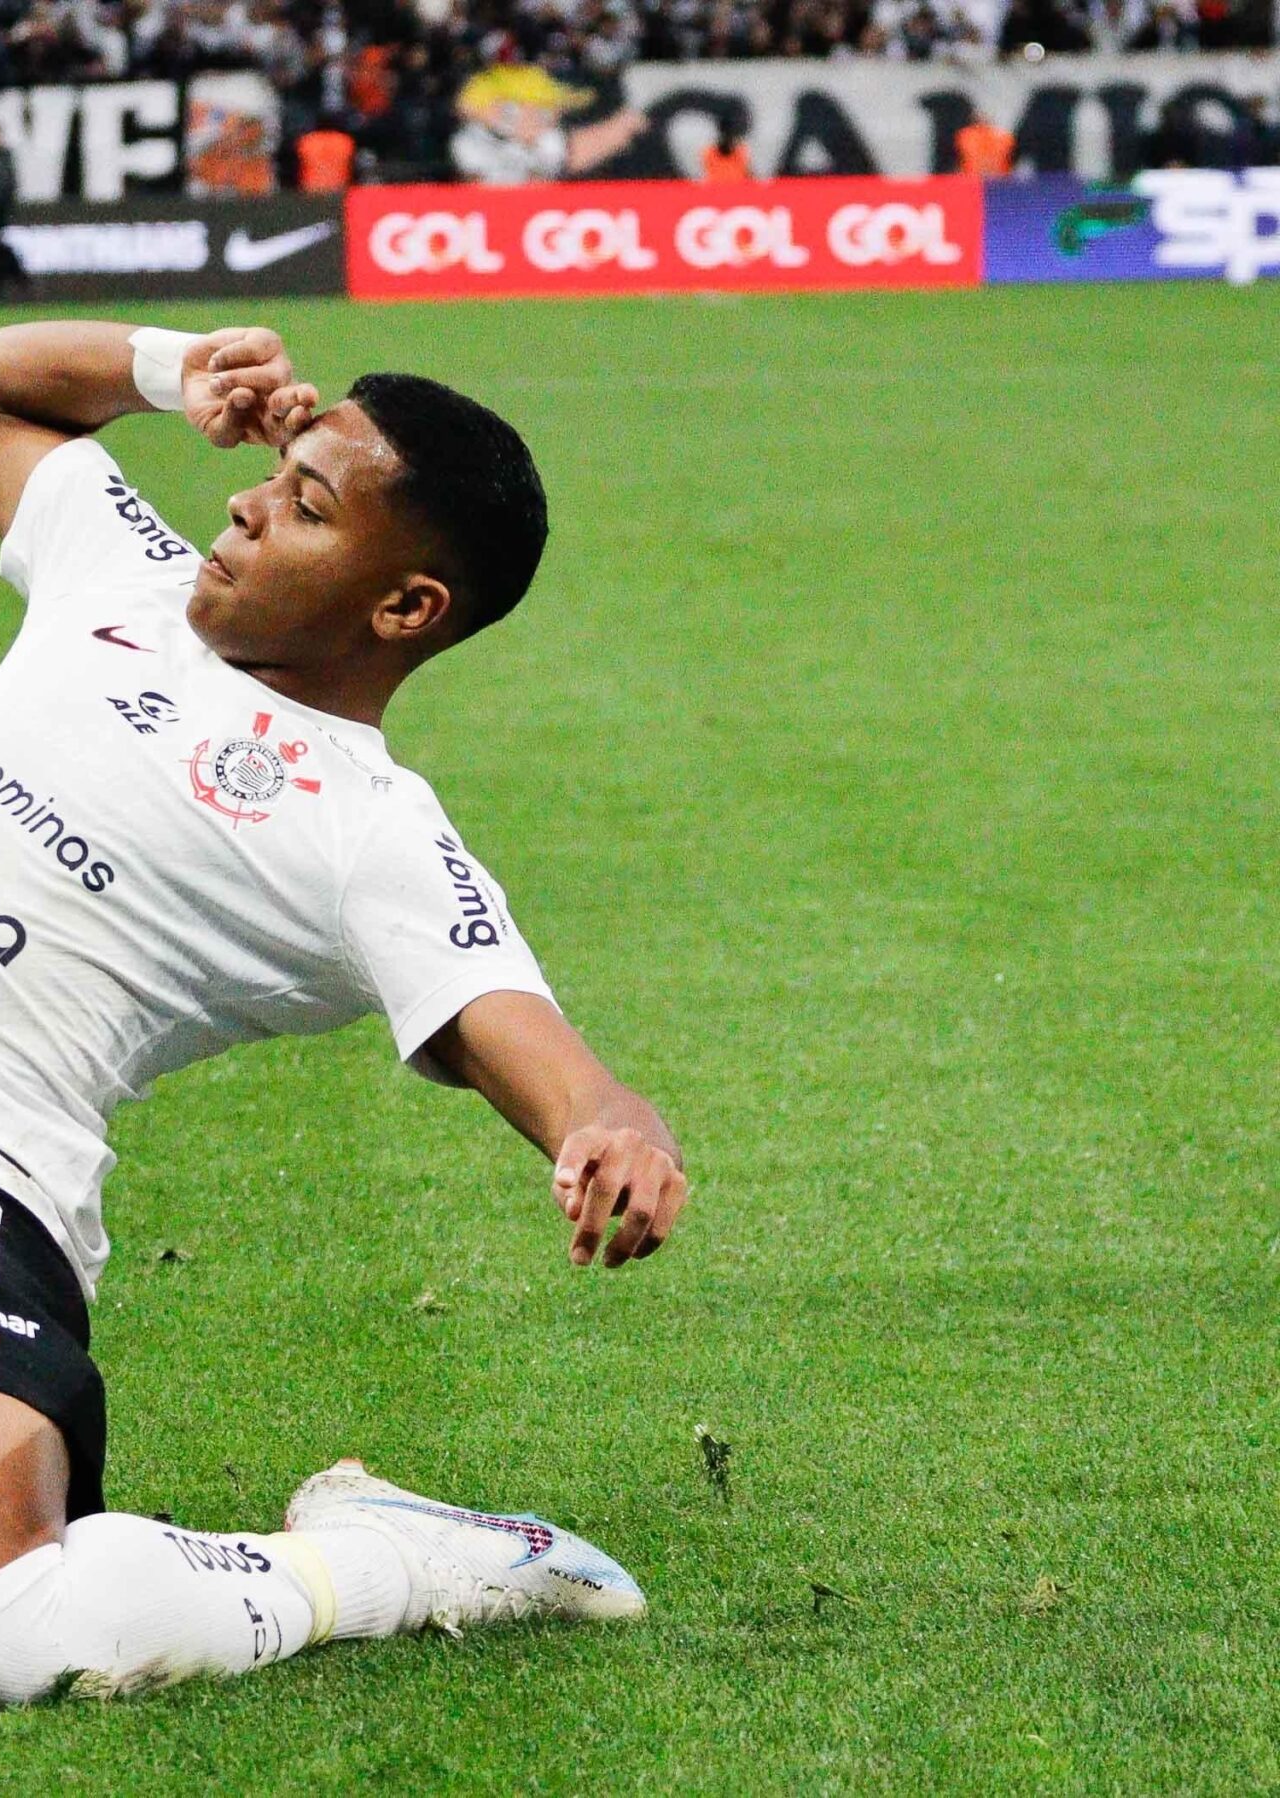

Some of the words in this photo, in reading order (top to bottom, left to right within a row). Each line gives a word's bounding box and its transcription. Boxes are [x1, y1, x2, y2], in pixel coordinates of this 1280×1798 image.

[370, 211, 504, 274] GOL
[523, 208, 658, 271] GOL
[675, 205, 810, 268] GOL
[827, 202, 961, 265] GOL
[114, 495, 191, 562] bmg
[106, 696, 158, 734] ALE
[441, 854, 500, 949] bmg
